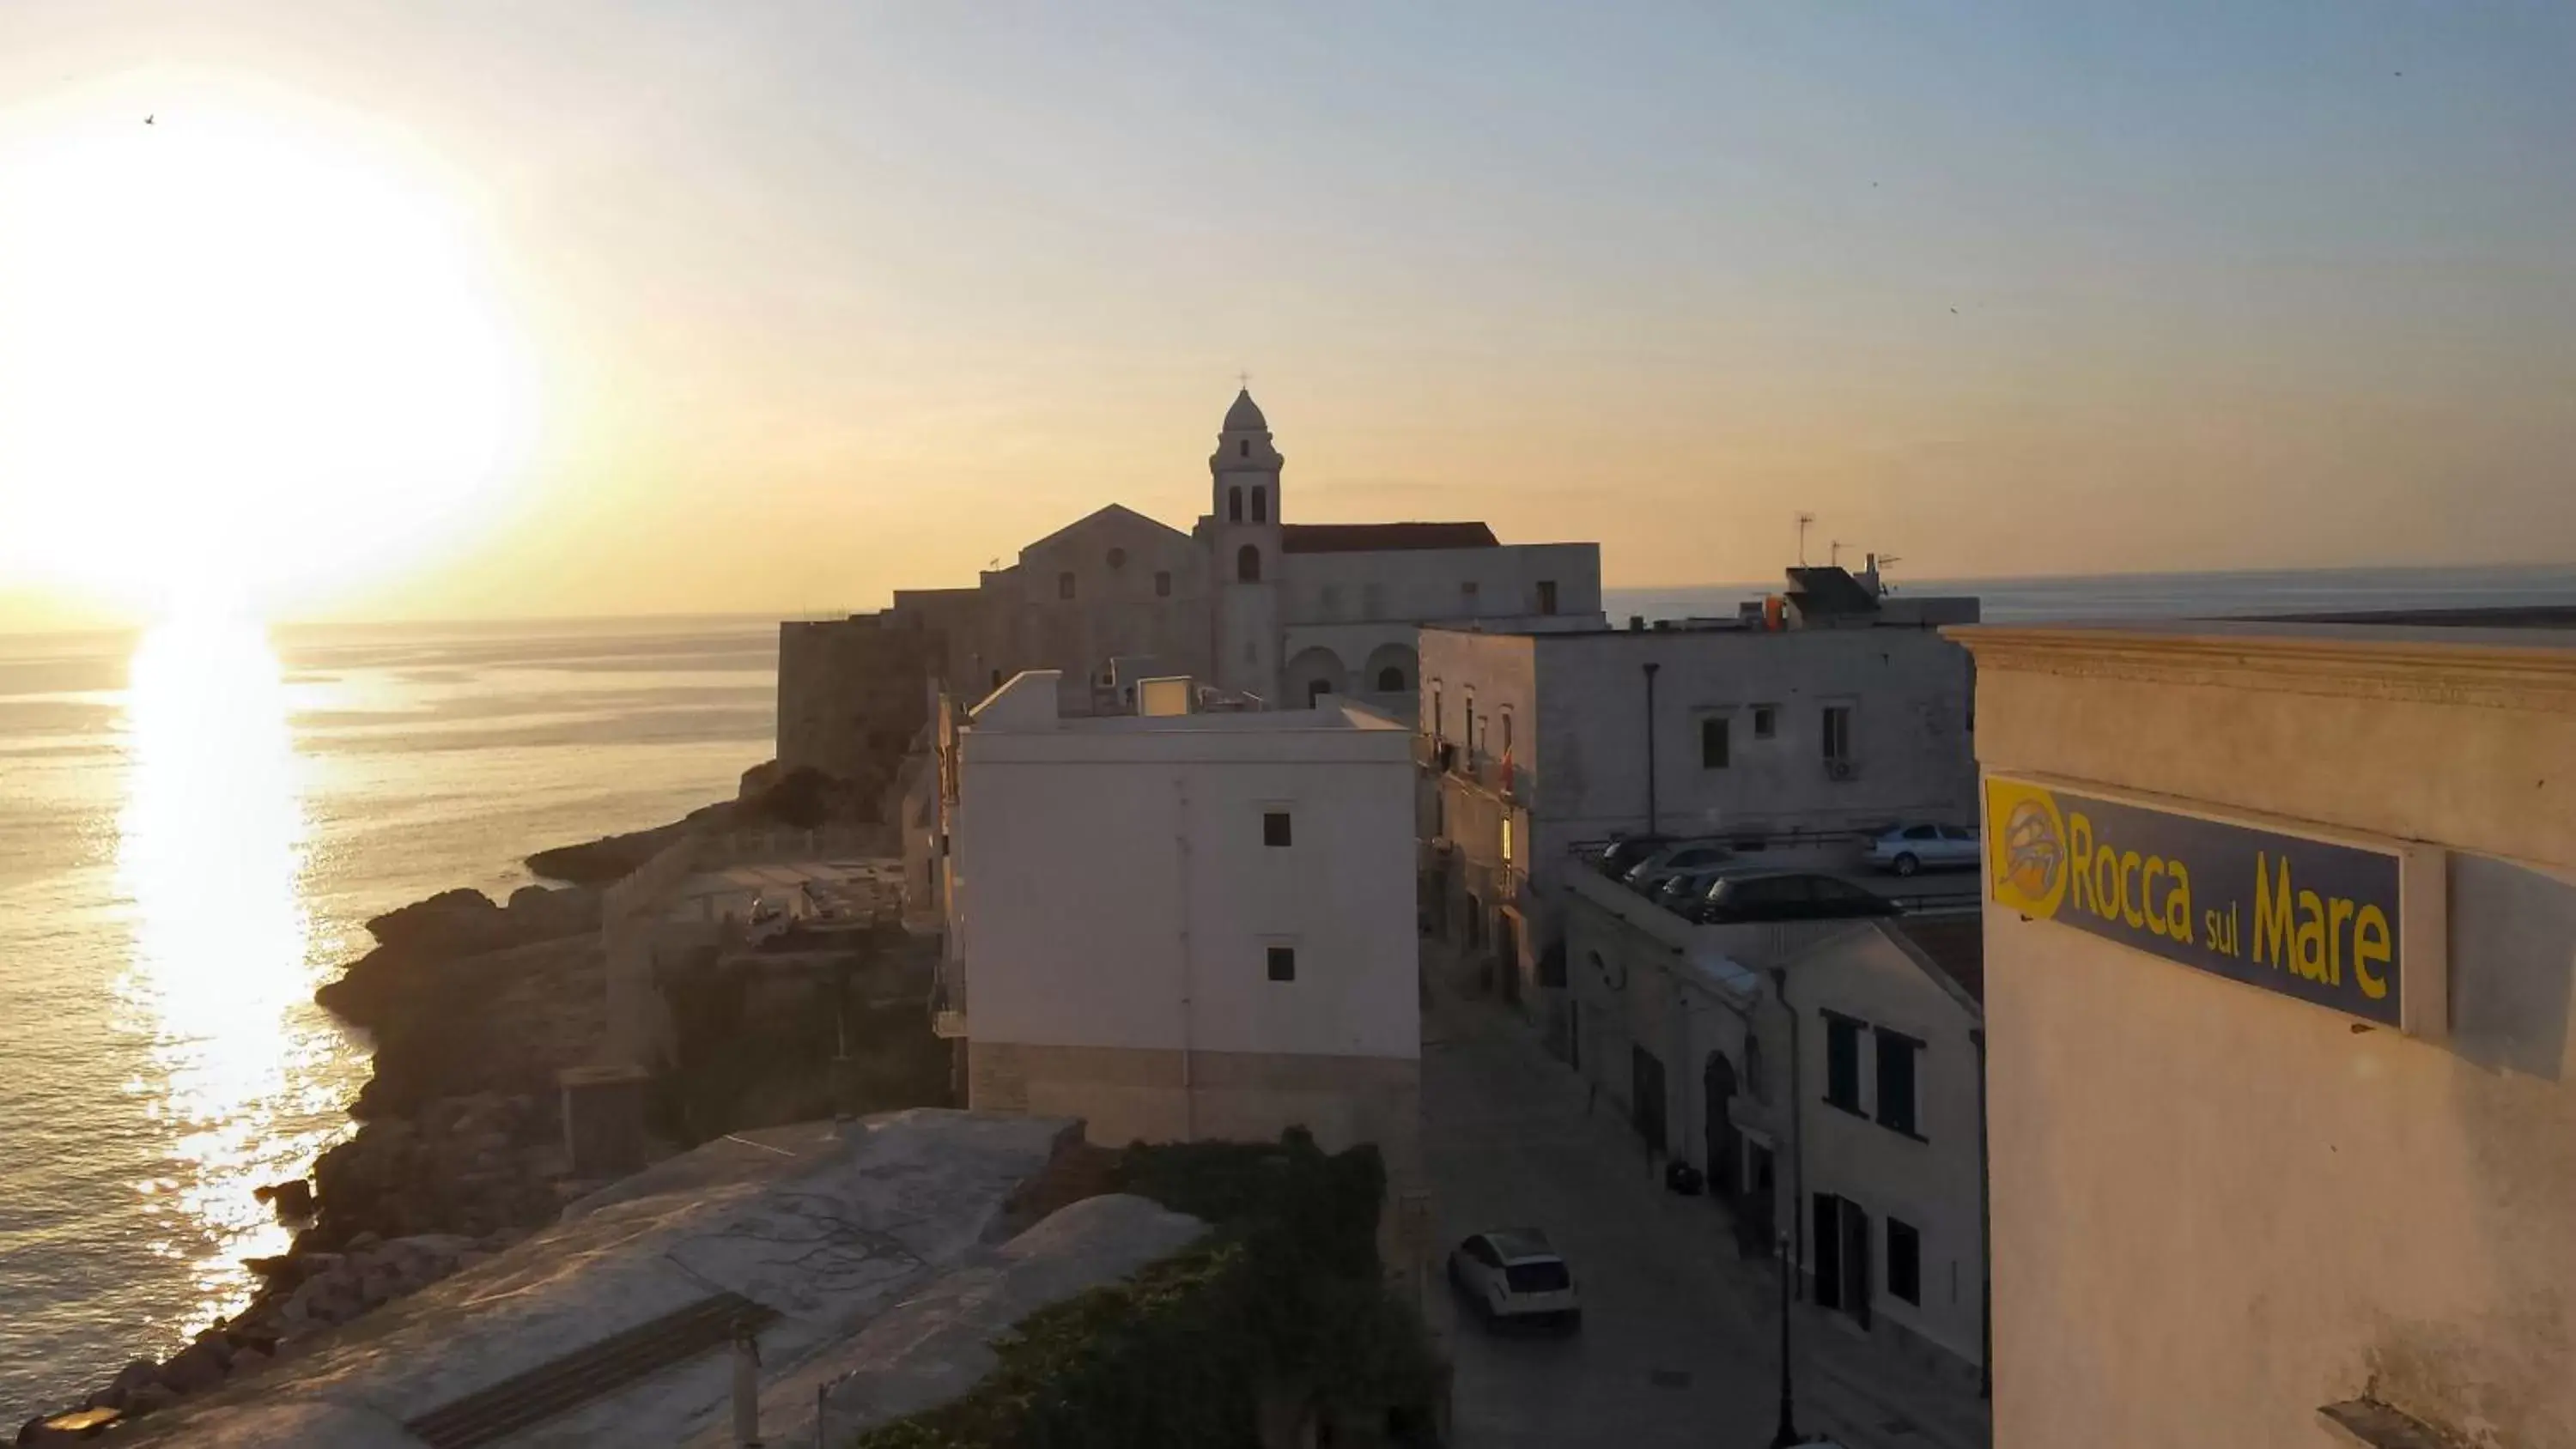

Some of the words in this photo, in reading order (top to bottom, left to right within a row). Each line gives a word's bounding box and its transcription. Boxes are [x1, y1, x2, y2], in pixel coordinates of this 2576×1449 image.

[2069, 813, 2193, 943] Rocca
[2206, 900, 2239, 957] sul
[2253, 852, 2391, 999] Mare
